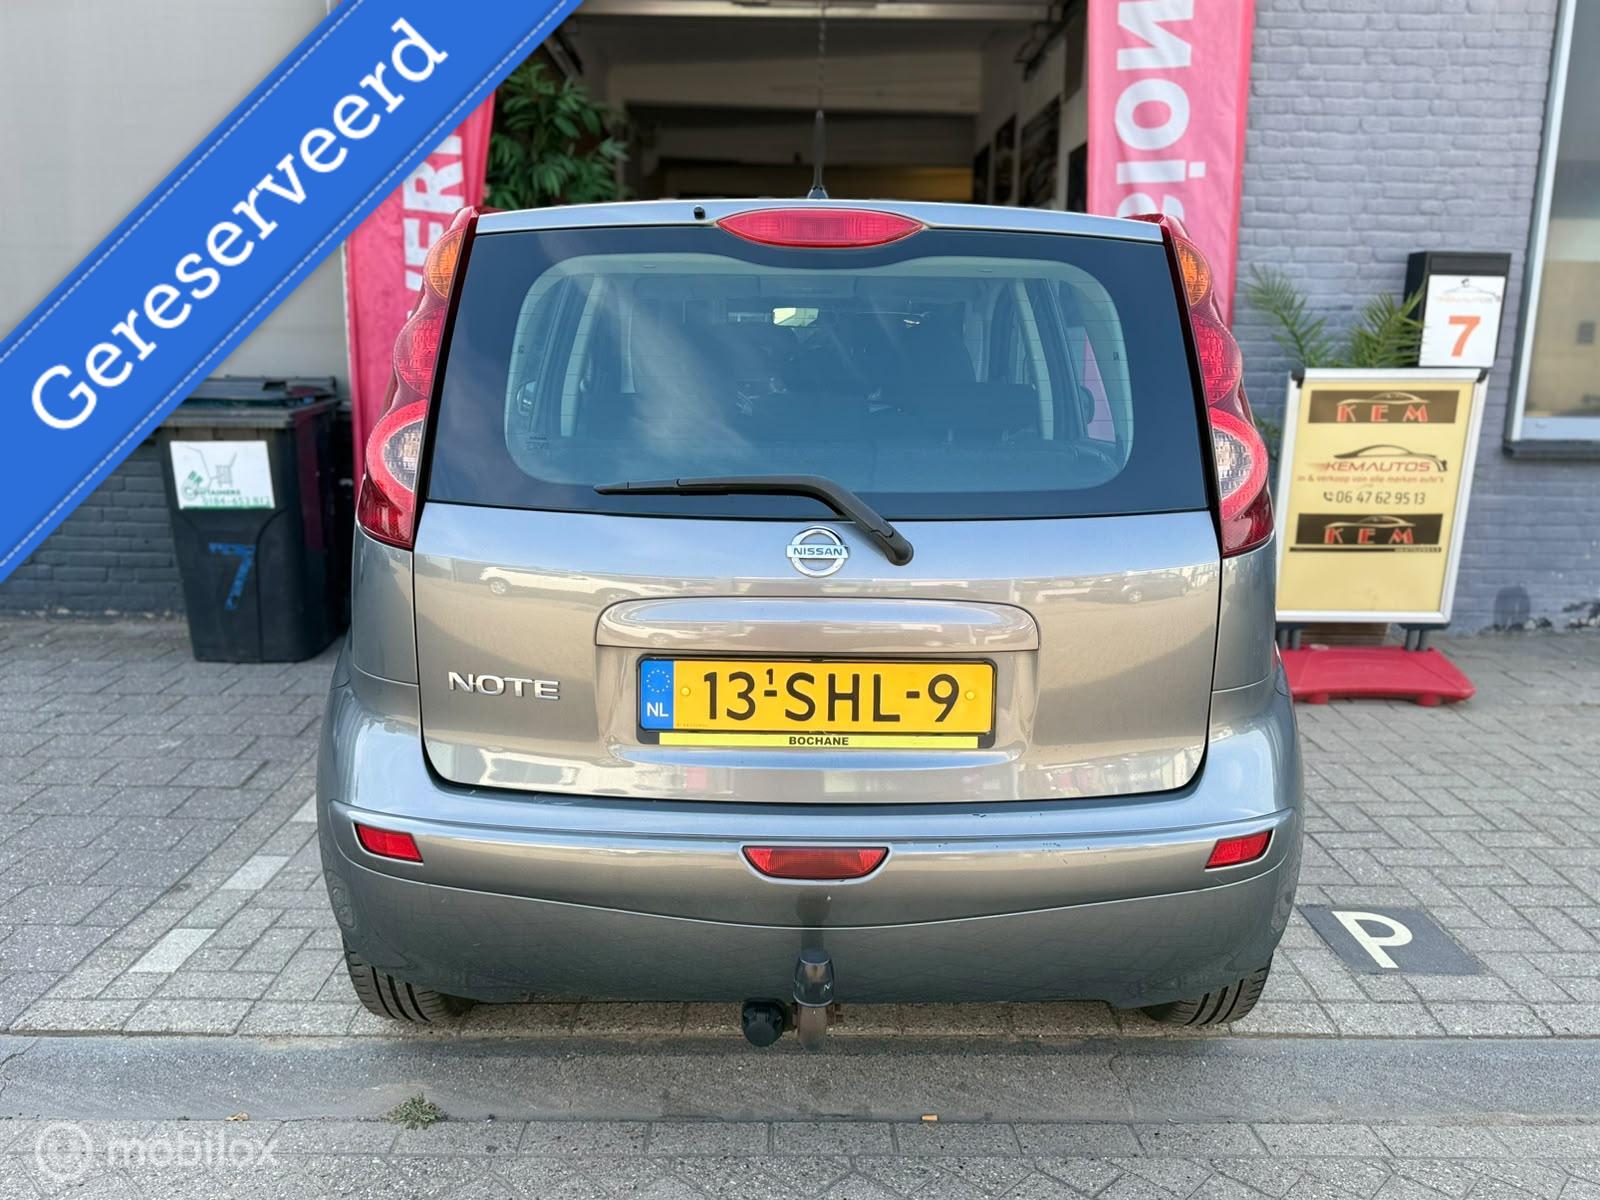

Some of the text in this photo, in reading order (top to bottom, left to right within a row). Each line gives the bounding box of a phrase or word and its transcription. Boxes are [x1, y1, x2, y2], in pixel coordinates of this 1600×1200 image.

[1448, 315, 1481, 357] 7
[1336, 404, 1428, 422] KEM
[1336, 491, 1426, 505] 06 47 62 95 13
[1324, 528, 1414, 544] KEM
[793, 547, 843, 556] NISSAN
[208, 542, 257, 611] 7
[448, 672, 560, 700] NOTE
[647, 702, 669, 718] NL
[788, 736, 849, 746] BOCHANE
[1331, 911, 1413, 969] P
